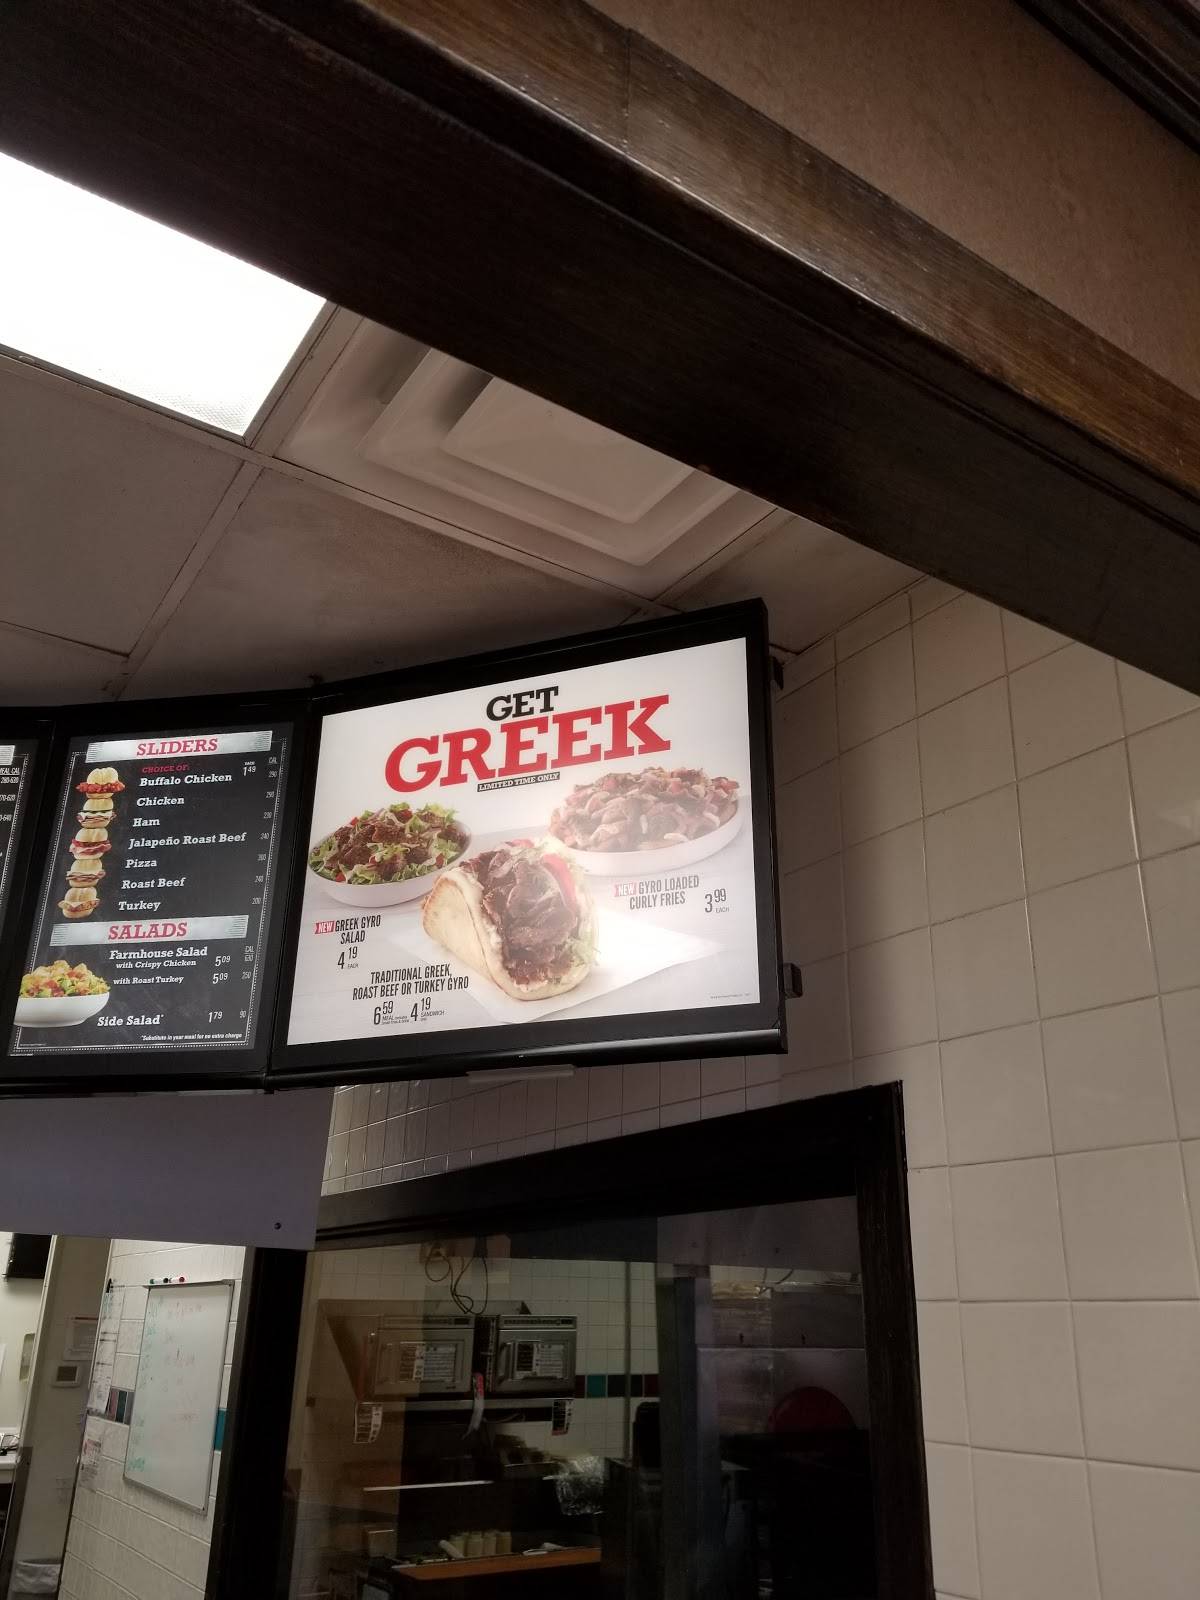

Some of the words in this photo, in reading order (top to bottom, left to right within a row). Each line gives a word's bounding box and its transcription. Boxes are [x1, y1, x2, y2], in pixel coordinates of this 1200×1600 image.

[486, 685, 559, 722] GET
[136, 738, 219, 756] SLIDERS
[384, 694, 671, 793] GREEK
[142, 765, 175, 774] CHOICE
[139, 776, 181, 787] Buffalo
[184, 774, 232, 784] Chicken
[479, 780, 514, 792] LIMITED
[515, 776, 536, 786] TIME
[537, 772, 560, 783] ONLY
[136, 796, 185, 807] Chicken
[132, 818, 160, 828] Ham
[128, 837, 180, 849] Jalapeño
[182, 834, 216, 845] Roast
[218, 832, 247, 843] Beef
[125, 858, 158, 869] Pizza
[121, 879, 155, 890] Roast
[157, 877, 187, 888] Beef
[617, 882, 634, 897] NEW
[638, 879, 662, 895] GYRO
[664, 874, 700, 891] LOADED
[118, 900, 161, 912] Turkey
[629, 894, 658, 910] CURLY
[660, 890, 686, 907] FRIES
[108, 922, 188, 940] SALADS
[317, 921, 334, 934] NEW
[335, 918, 359, 932] GREEK
[361, 914, 381, 929] GYRO
[340, 930, 366, 945] SALAD
[109, 948, 173, 960] Farmhouse
[175, 946, 208, 957] Salad
[115, 961, 133, 969] with
[135, 960, 162, 970] Crispy
[163, 959, 197, 968] Chicken
[113, 977, 131, 985] with
[132, 976, 155, 985] Roast
[155, 975, 185, 985] Turkey
[370, 966, 423, 985] TRADITIONAL
[424, 963, 453, 980] GREEK,
[352, 985, 378, 1001] ROAST
[380, 983, 400, 998] BEEF
[401, 982, 412, 996] OR
[414, 978, 446, 995] TURKEY
[447, 975, 470, 991] GYRO
[420, 1010, 445, 1018] SANDWICH
[97, 1016, 124, 1027] Side
